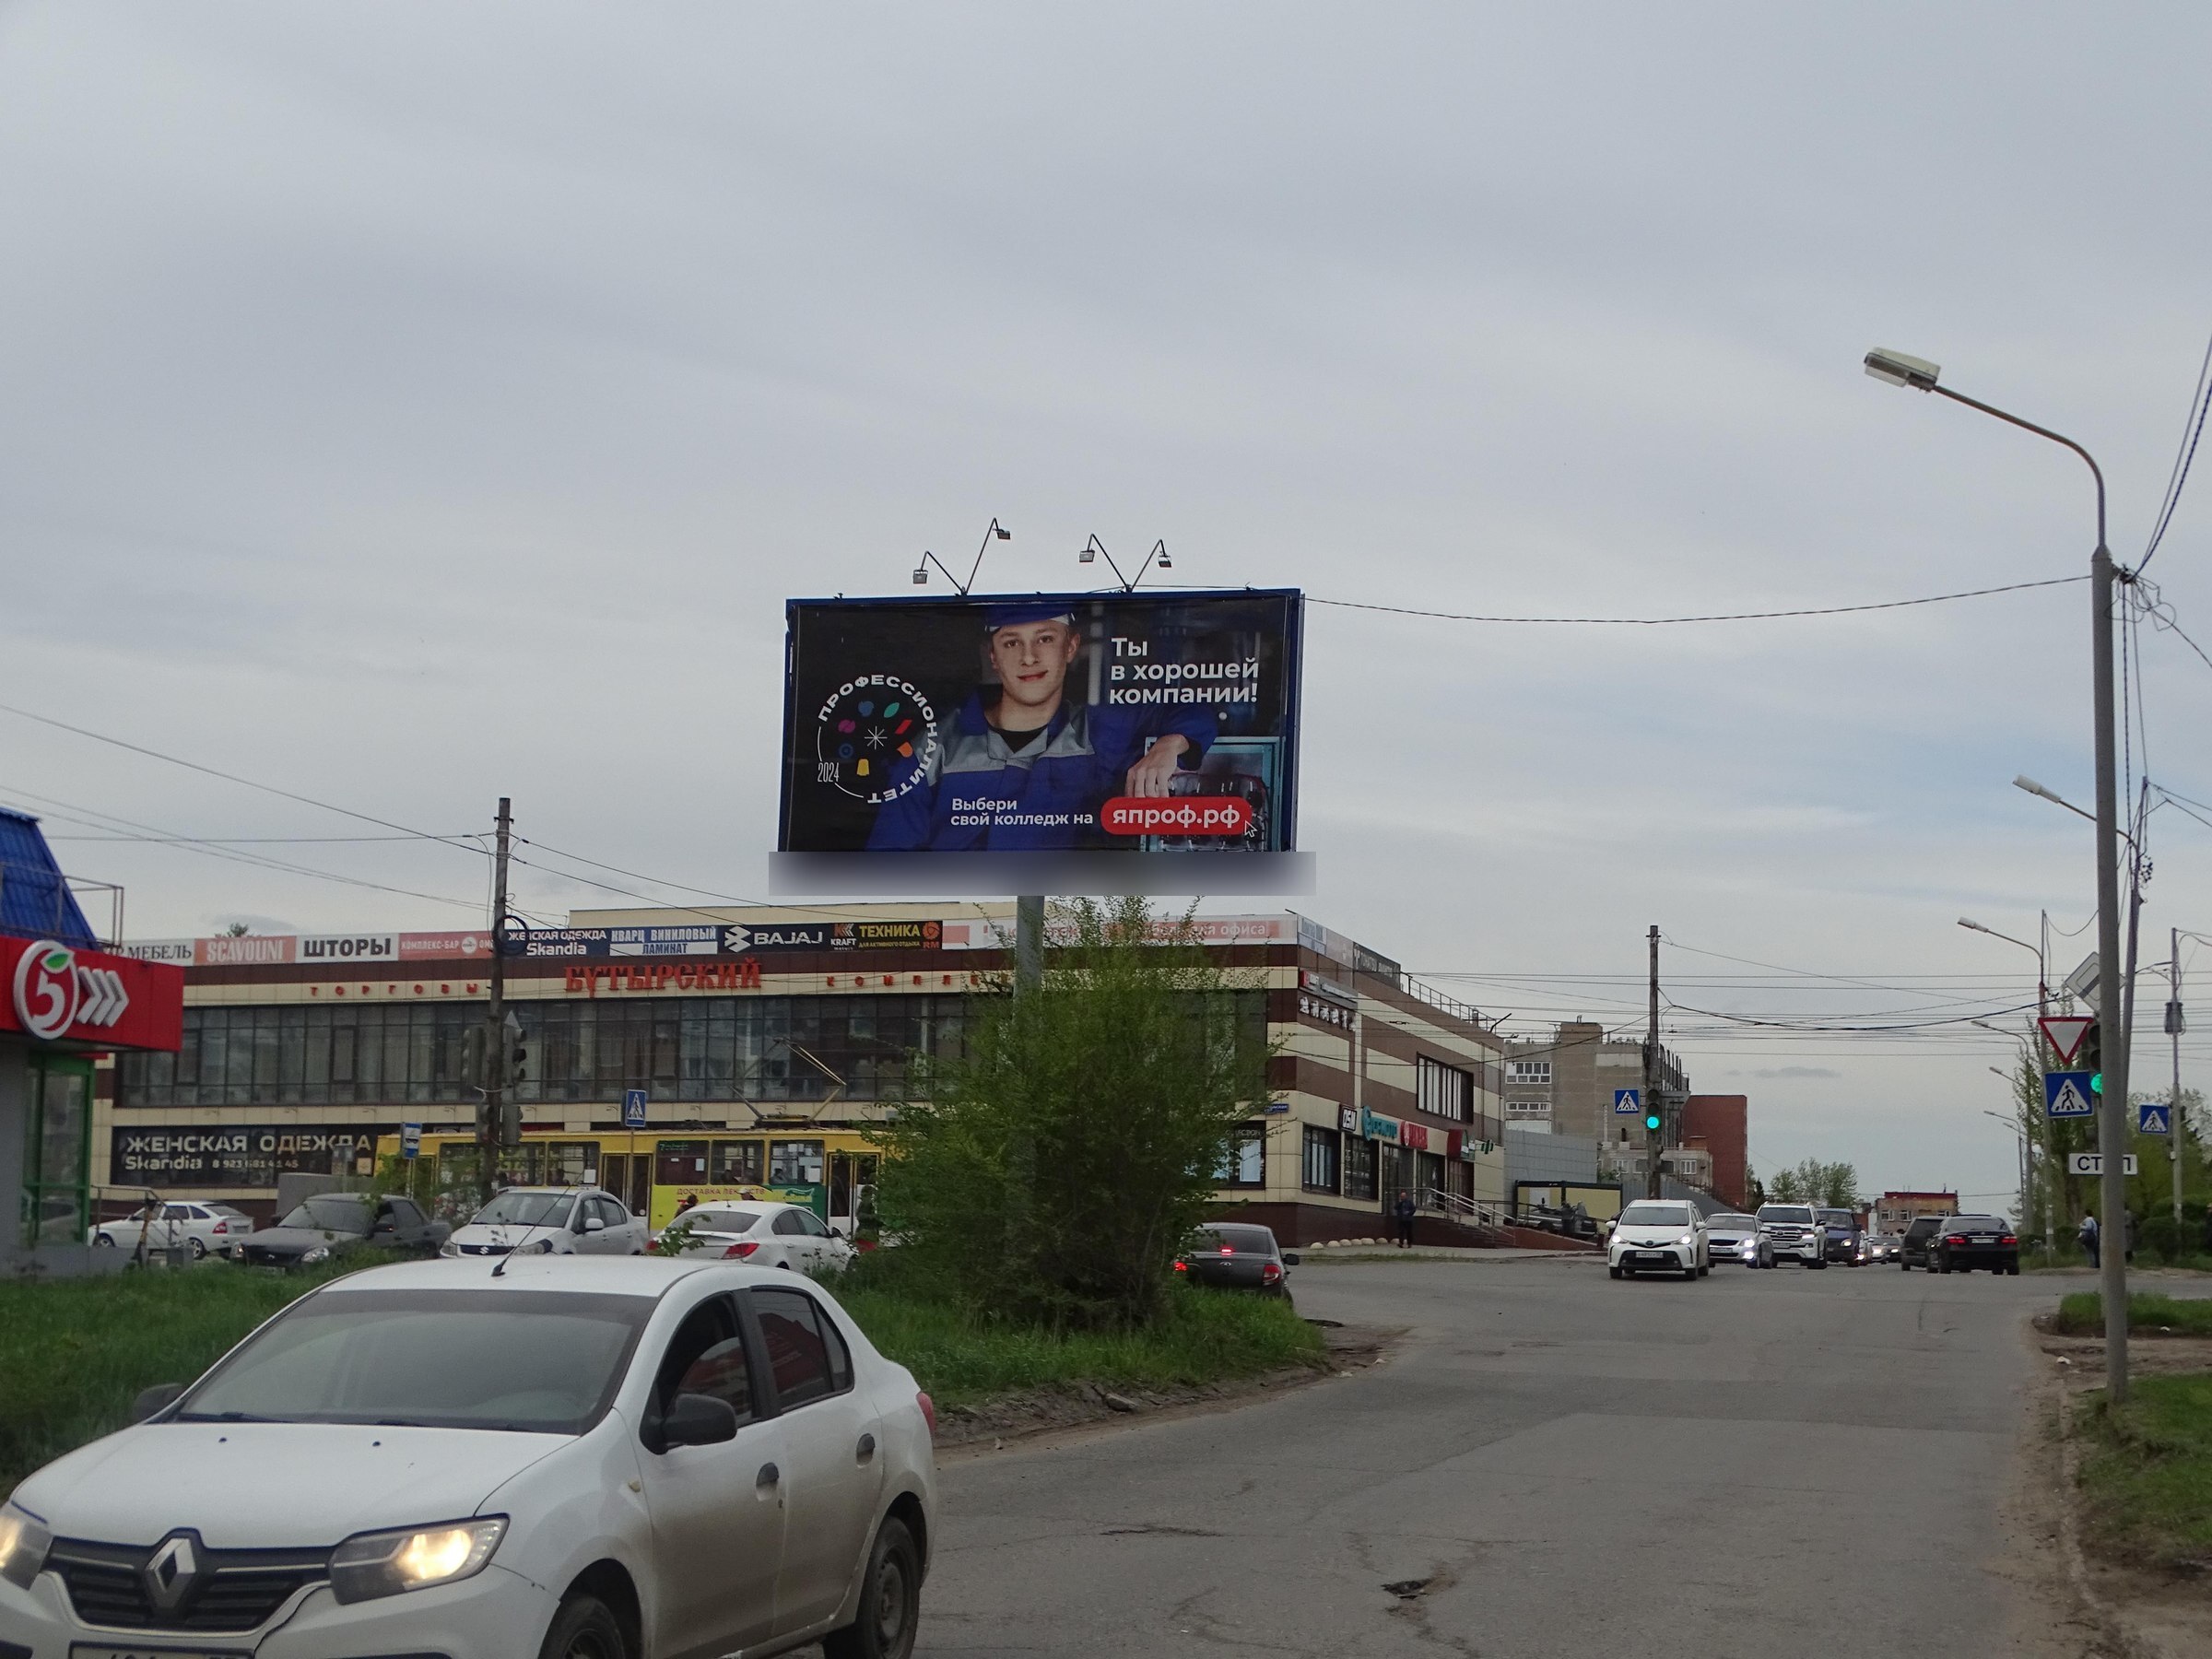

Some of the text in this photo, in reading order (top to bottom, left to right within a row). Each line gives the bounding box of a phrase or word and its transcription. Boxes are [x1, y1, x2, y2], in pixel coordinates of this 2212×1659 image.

[1111, 637, 1148, 657] Ты
[1111, 656, 1260, 685] в хорошей
[1109, 682, 1259, 705] компании!
[818, 674, 938, 804] ПРОФЕССИОНАЛИТЕТ
[817, 761, 841, 782] 2024
[951, 797, 1018, 814] Выбери
[950, 811, 1094, 827] свой колледж на
[1112, 804, 1241, 829] япроф.рф
[559, 929, 607, 940] ОДЕЖДА
[611, 925, 717, 943] КВАРЦ ВИНИЛОВЫЙ
[753, 931, 823, 946] BAJAJ
[858, 924, 921, 938] ТЕХНИКА
[1219, 923, 1266, 939] офиса
[303, 937, 392, 958] ШТОРЫ
[526, 942, 587, 957] Skandia
[641, 942, 688, 955] ЛАМИНАТ
[830, 937, 857, 947] KRAFT
[923, 941, 939, 949] RM
[127, 944, 192, 959] МЕБЕЛЬ
[565, 958, 761, 998] БУТЫРСКИЙ
[310, 982, 479, 996] ТОРГОВЫ
[31, 969, 65, 1030] 5
[126, 1135, 371, 1154] ЖЕНСКАЯ ОДЕЖДА
[124, 1156, 203, 1171] Skandia
[2077, 1156, 2131, 1171] СТП
